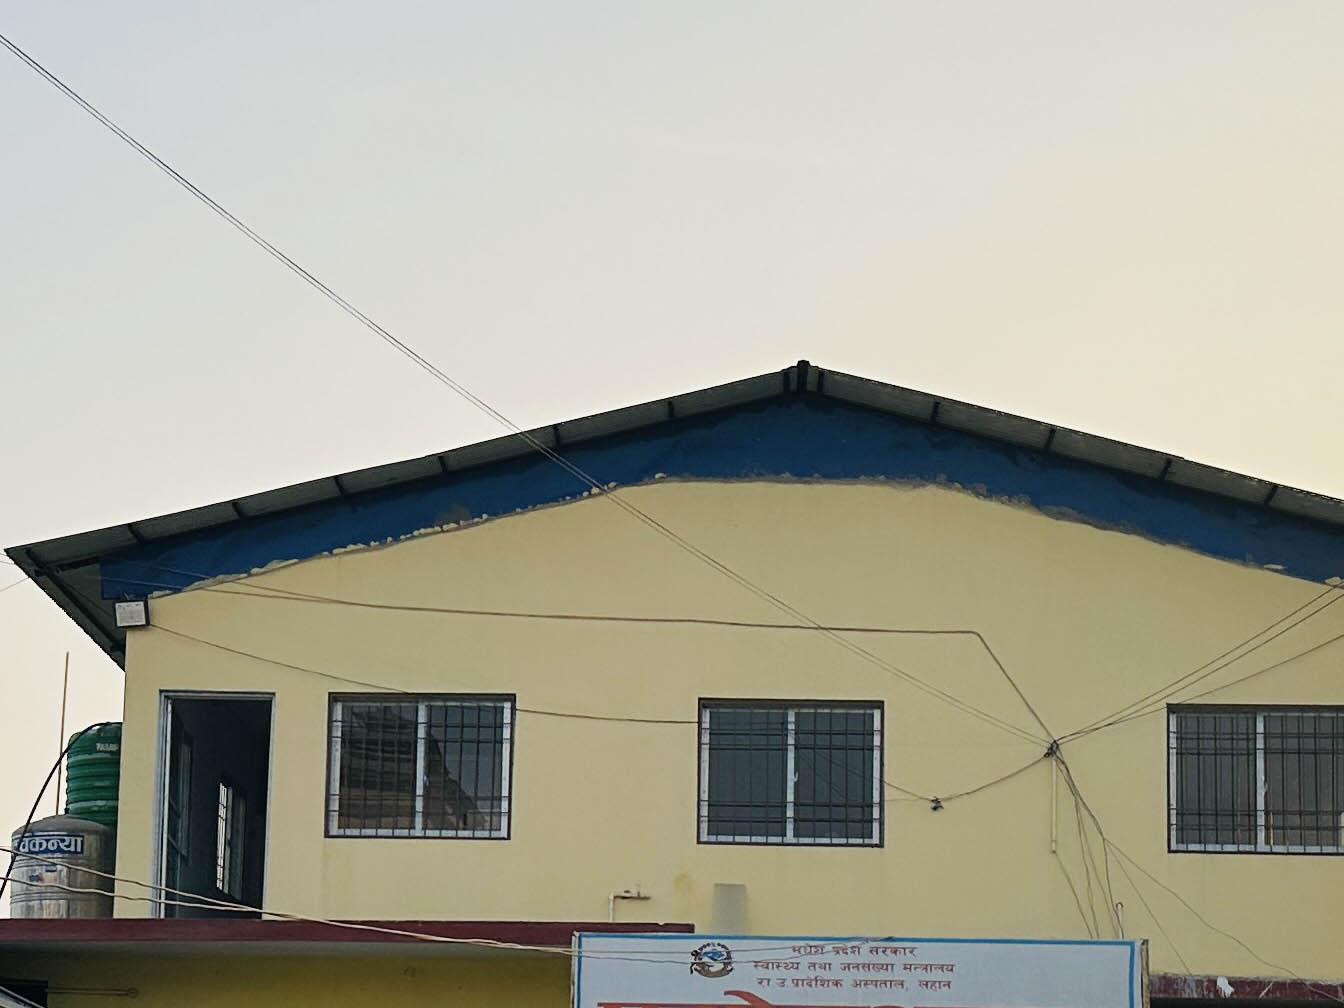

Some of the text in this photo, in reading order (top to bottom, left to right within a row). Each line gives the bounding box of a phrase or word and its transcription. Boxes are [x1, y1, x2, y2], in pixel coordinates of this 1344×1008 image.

[869, 946, 918, 956] सरकार
[808, 962, 832, 971] तथा
[903, 962, 956, 973] मन्त्रालय
